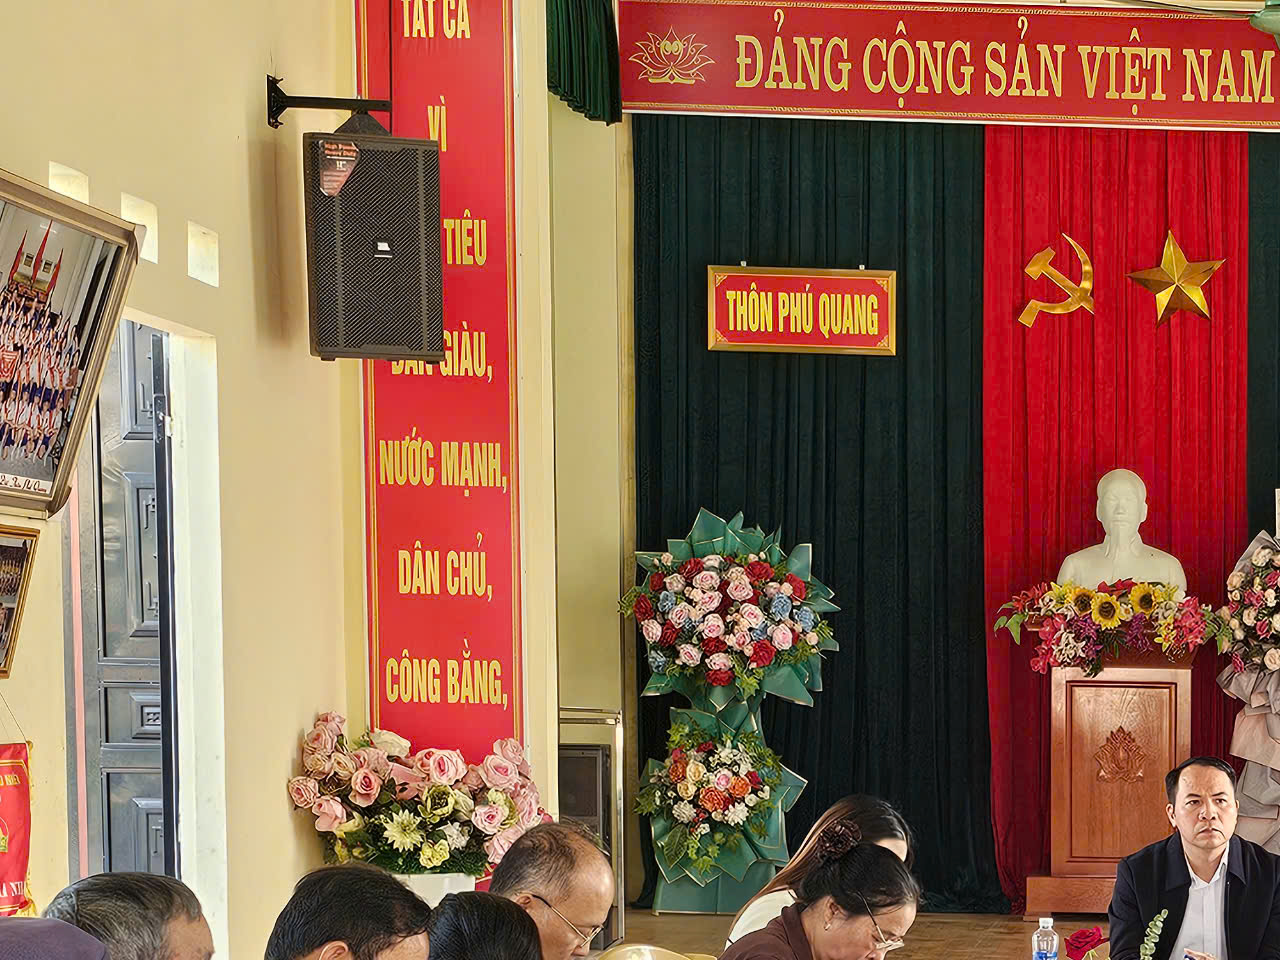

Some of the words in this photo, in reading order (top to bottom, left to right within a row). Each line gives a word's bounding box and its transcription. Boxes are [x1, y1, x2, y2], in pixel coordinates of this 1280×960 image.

[735, 8, 852, 92] ĐẢNG
[861, 20, 975, 109] CỘNG
[984, 16, 1064, 99] SẢN
[1077, 26, 1171, 116] VIỆT
[1181, 49, 1276, 104] NAM
[427, 95, 447, 152] VÌ
[443, 209, 488, 266] TIÊU
[726, 282, 773, 333] THÔN
[778, 284, 813, 334] PHÚ
[818, 292, 879, 339] QUANG
[440, 321, 493, 383] GIÀU,
[379, 427, 434, 486] NƯỚC
[441, 441, 507, 497] MẠNH,
[398, 540, 440, 595] DÂN
[446, 531, 493, 602] CHỦ,
[385, 648, 441, 704] CÔNG
[447, 638, 508, 711] BẰNG,
